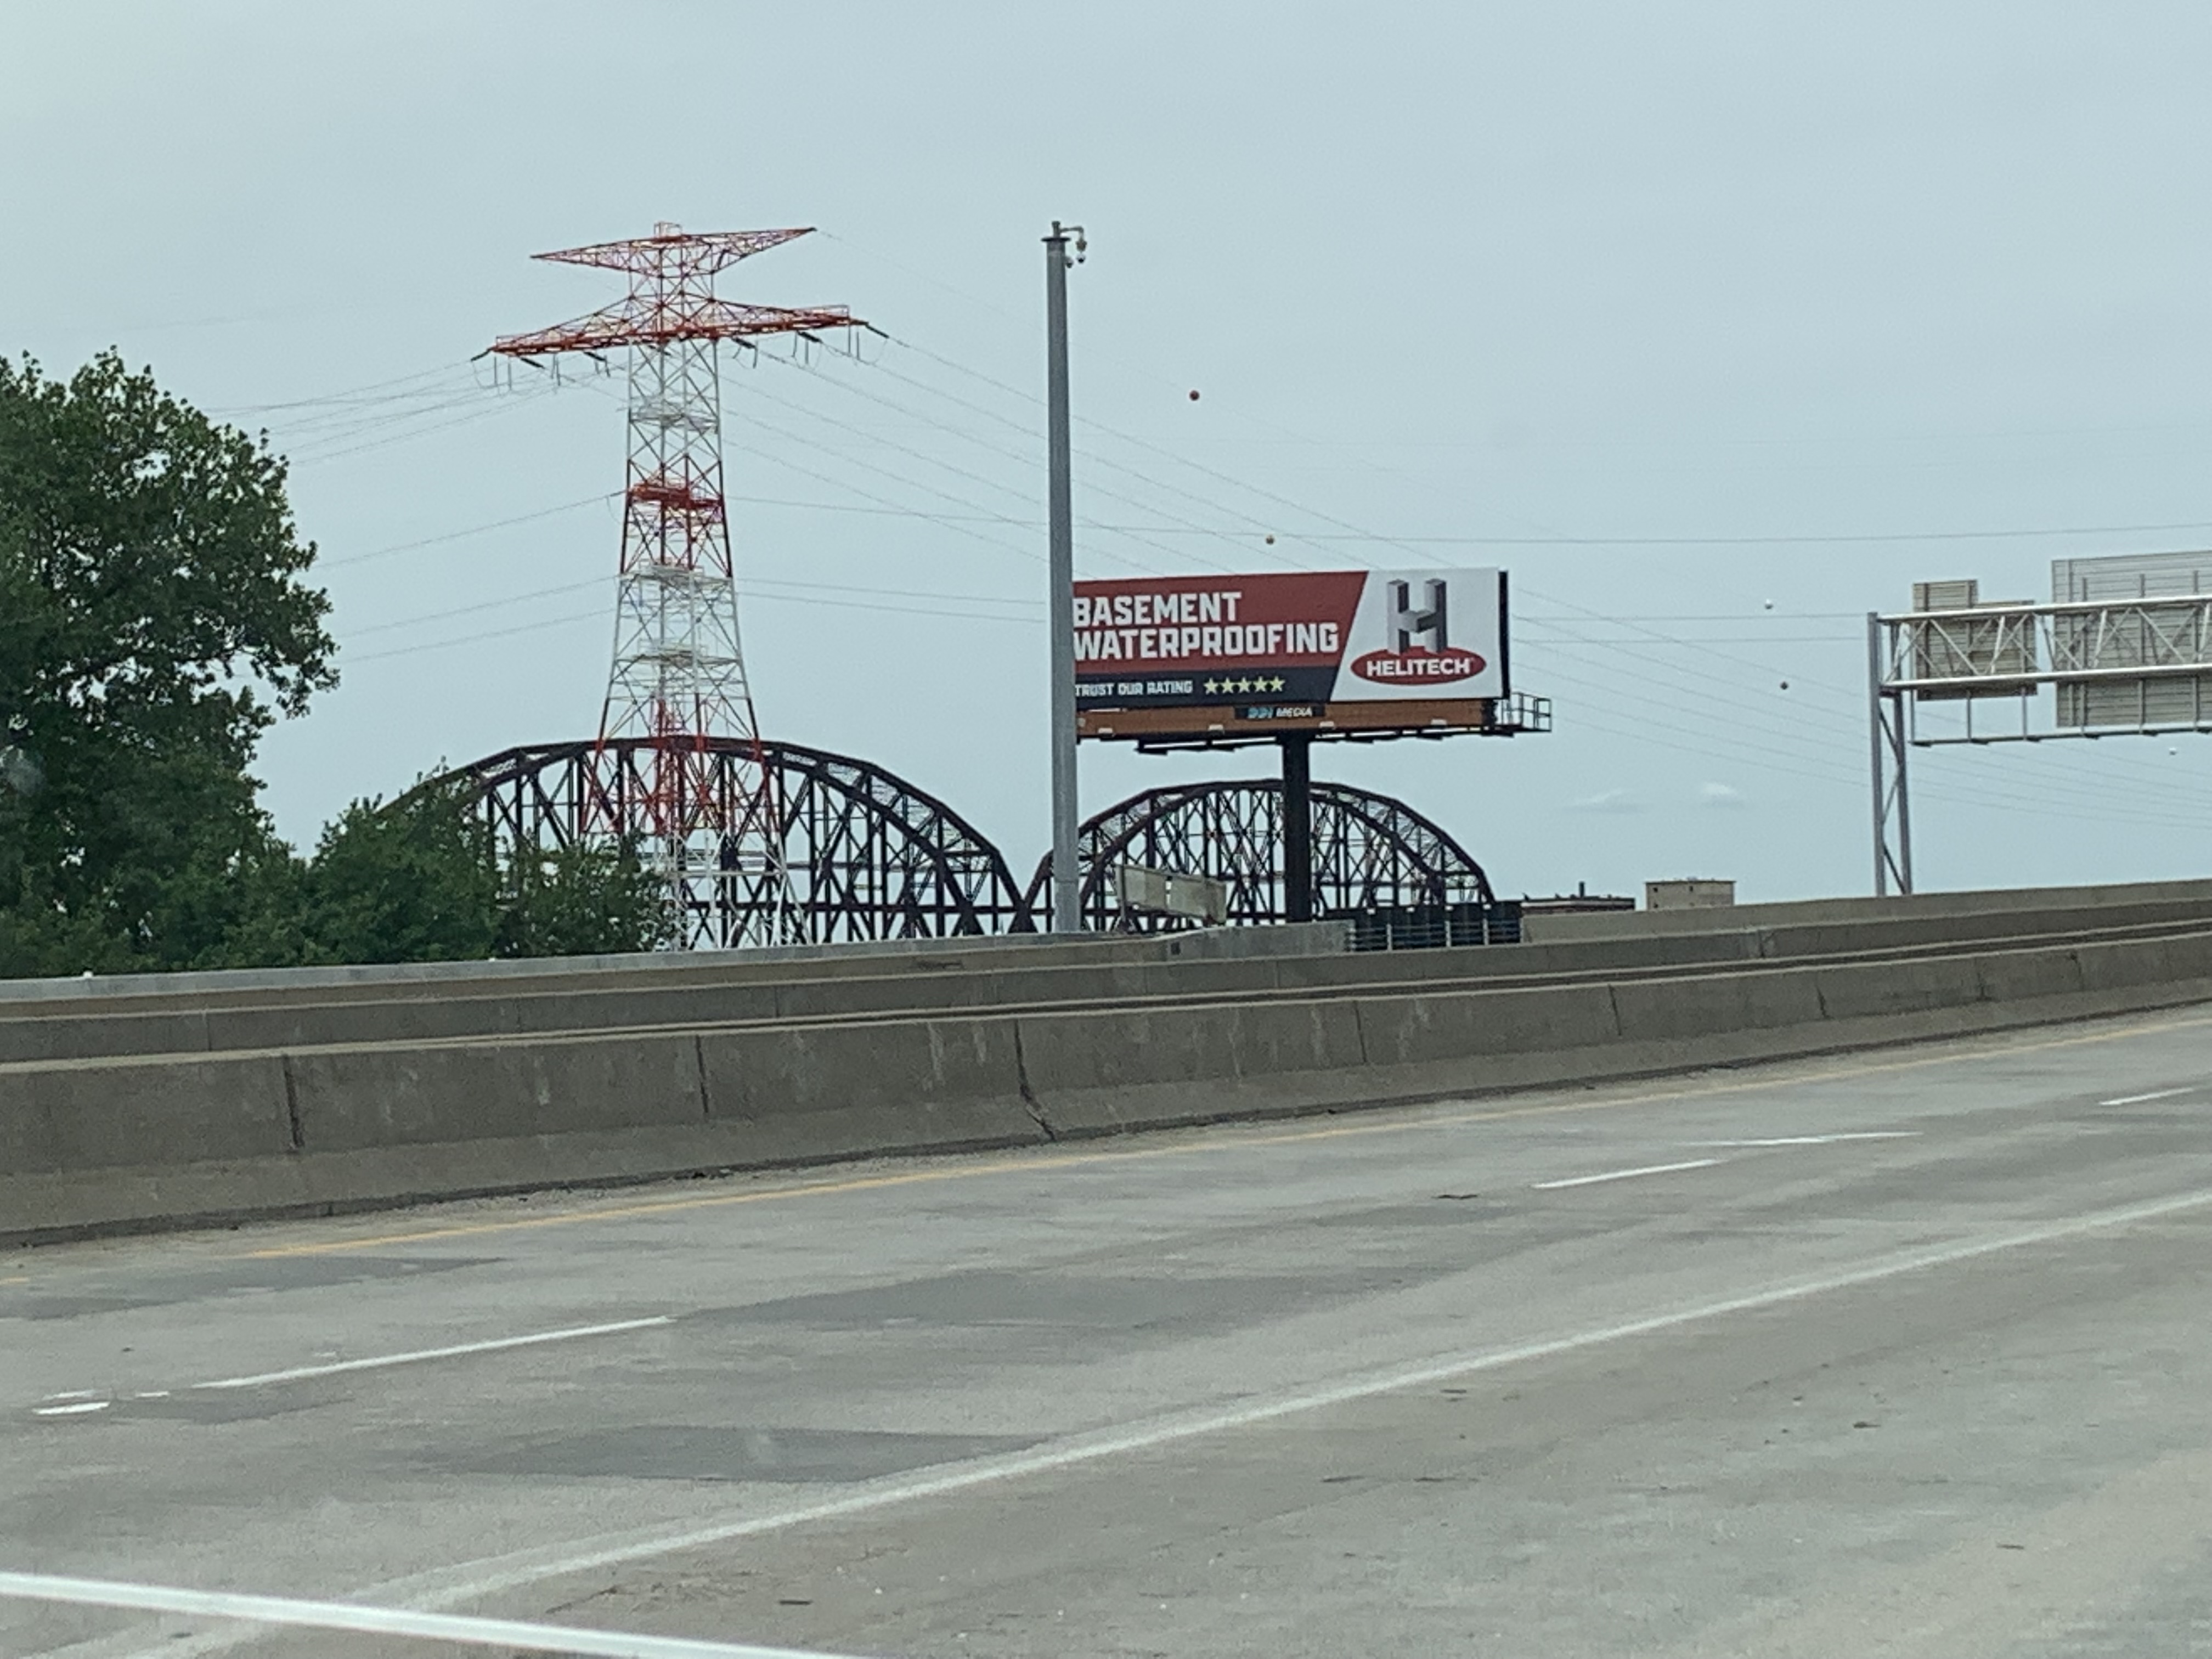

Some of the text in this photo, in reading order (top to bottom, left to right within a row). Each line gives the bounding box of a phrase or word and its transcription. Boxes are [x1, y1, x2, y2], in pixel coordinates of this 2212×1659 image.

[1073, 592, 1242, 628] BASEMENT
[1074, 622, 1339, 661] WATERPROOFING
[1367, 658, 1472, 677] HELITECH
[1075, 680, 1193, 697] TRUST OUR RATING
[1276, 707, 1313, 717] MEDIA
